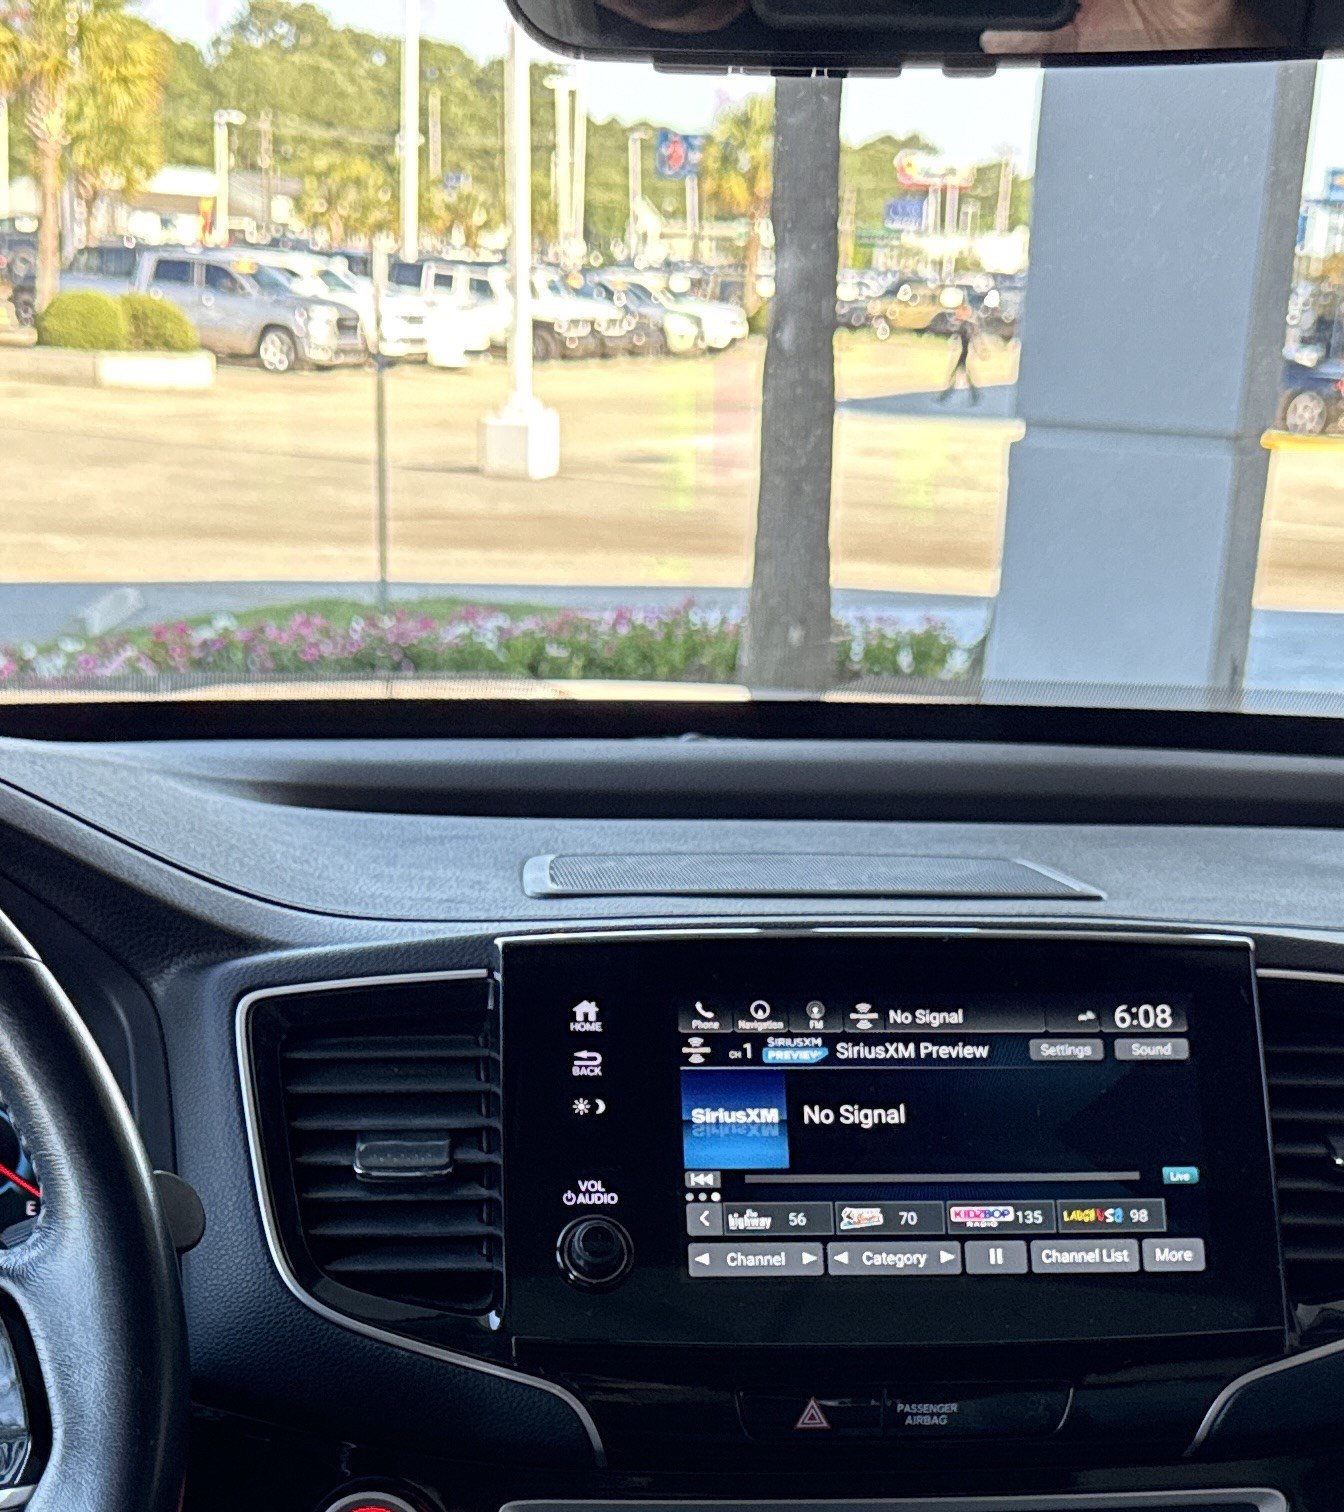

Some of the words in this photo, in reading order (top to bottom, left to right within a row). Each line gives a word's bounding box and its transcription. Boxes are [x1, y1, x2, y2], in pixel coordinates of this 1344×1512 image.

[889, 1009, 912, 1024] No
[915, 1008, 964, 1027] Signal
[1114, 1004, 1173, 1028] 6:08
[570, 1022, 603, 1032] HOME
[691, 1020, 720, 1030] Phone
[738, 1020, 784, 1031] Navigation
[742, 1043, 753, 1059] 1
[836, 1042, 916, 1059] SiriusXM
[920, 1042, 990, 1059] Preview
[1040, 1043, 1092, 1059] Settings
[1131, 1043, 1172, 1056] Sound
[572, 1066, 603, 1076] BACK
[691, 1108, 779, 1124] SiriusXM
[803, 1105, 835, 1125] No
[839, 1103, 906, 1129] Signal
[1170, 1171, 1191, 1182] Live
[577, 1180, 606, 1191] VOL
[576, 1193, 619, 1205] AUDIO
[25, 1200, 37, 1216] E
[788, 1212, 807, 1226] 56
[898, 1211, 918, 1226] 70
[1016, 1210, 1043, 1224] 135
[1130, 1208, 1149, 1223] 98
[726, 1252, 786, 1267] Channel
[862, 1251, 927, 1268] Category
[1041, 1248, 1100, 1263] Channel
[1102, 1249, 1130, 1263] List
[1155, 1248, 1193, 1262] More
[896, 1403, 959, 1413] PASSENGER
[905, 1414, 948, 1426] AIRBAG
